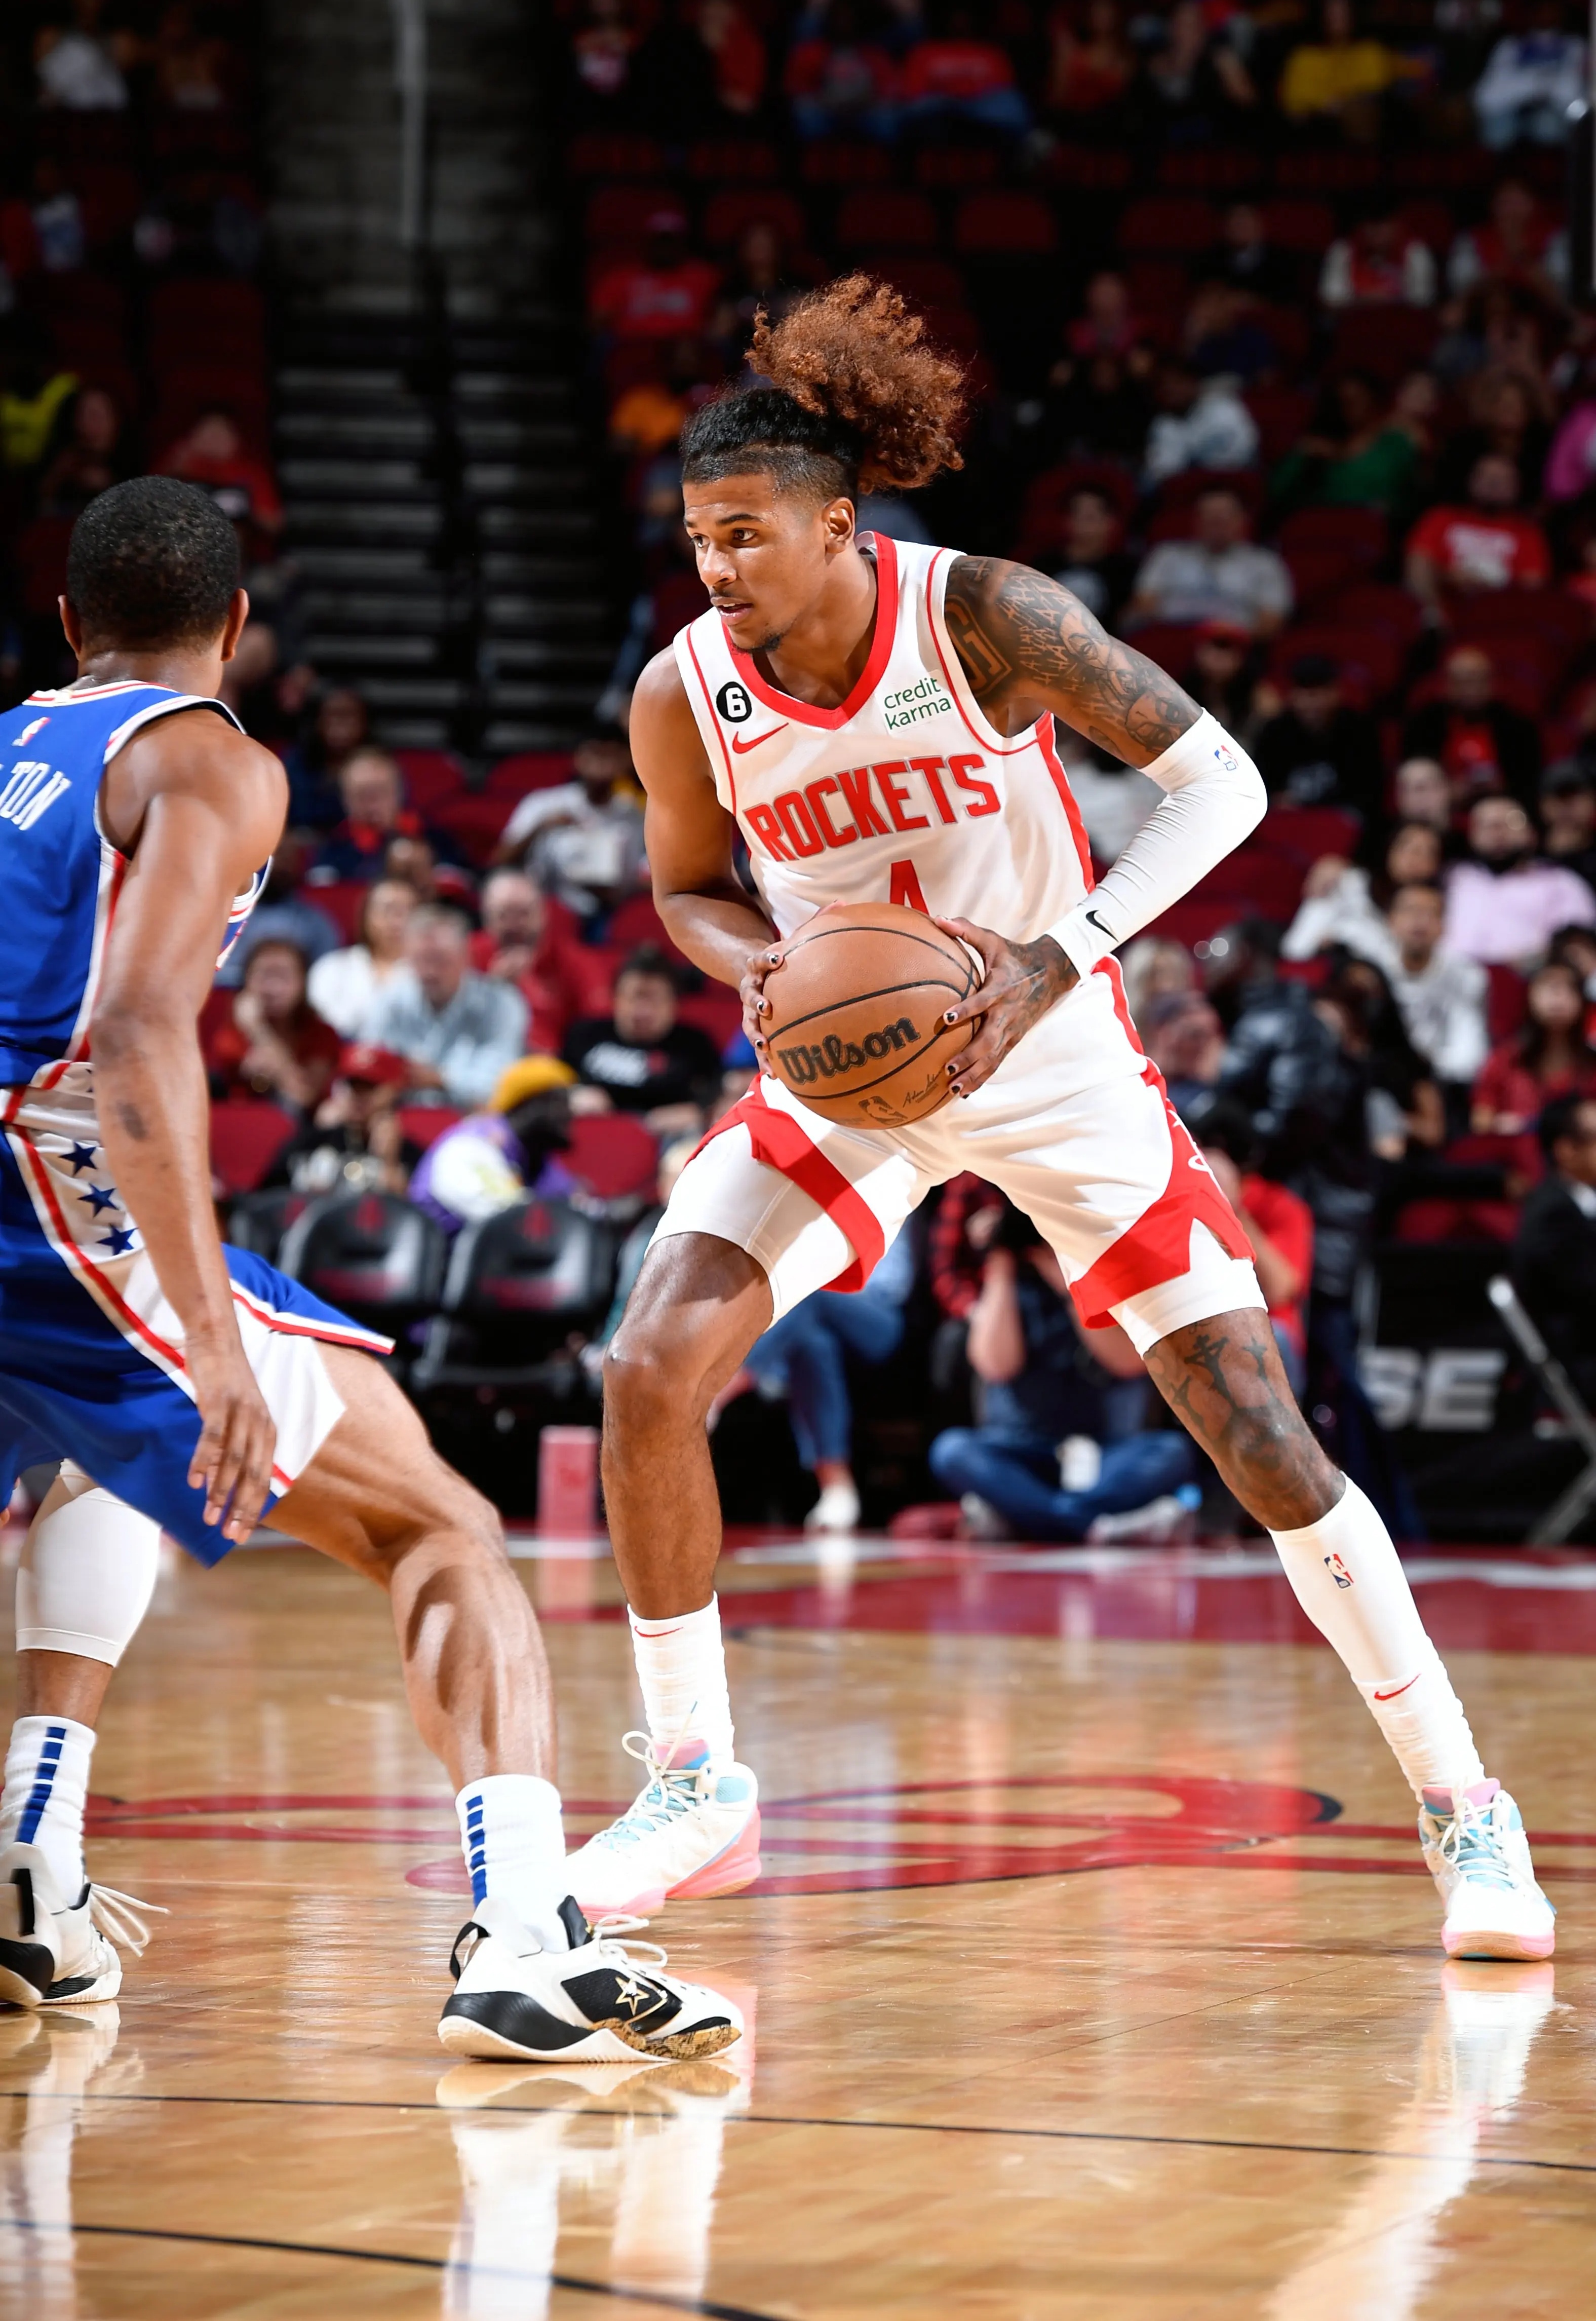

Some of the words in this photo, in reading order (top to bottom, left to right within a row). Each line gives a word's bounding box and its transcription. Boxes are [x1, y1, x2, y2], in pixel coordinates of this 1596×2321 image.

[725, 687, 748, 718] 6
[884, 677, 941, 709] credit
[884, 698, 951, 730] karma
[0, 761, 72, 831] TON
[743, 753, 1001, 862] ROCKETS
[776, 1017, 921, 1086] Wilson
